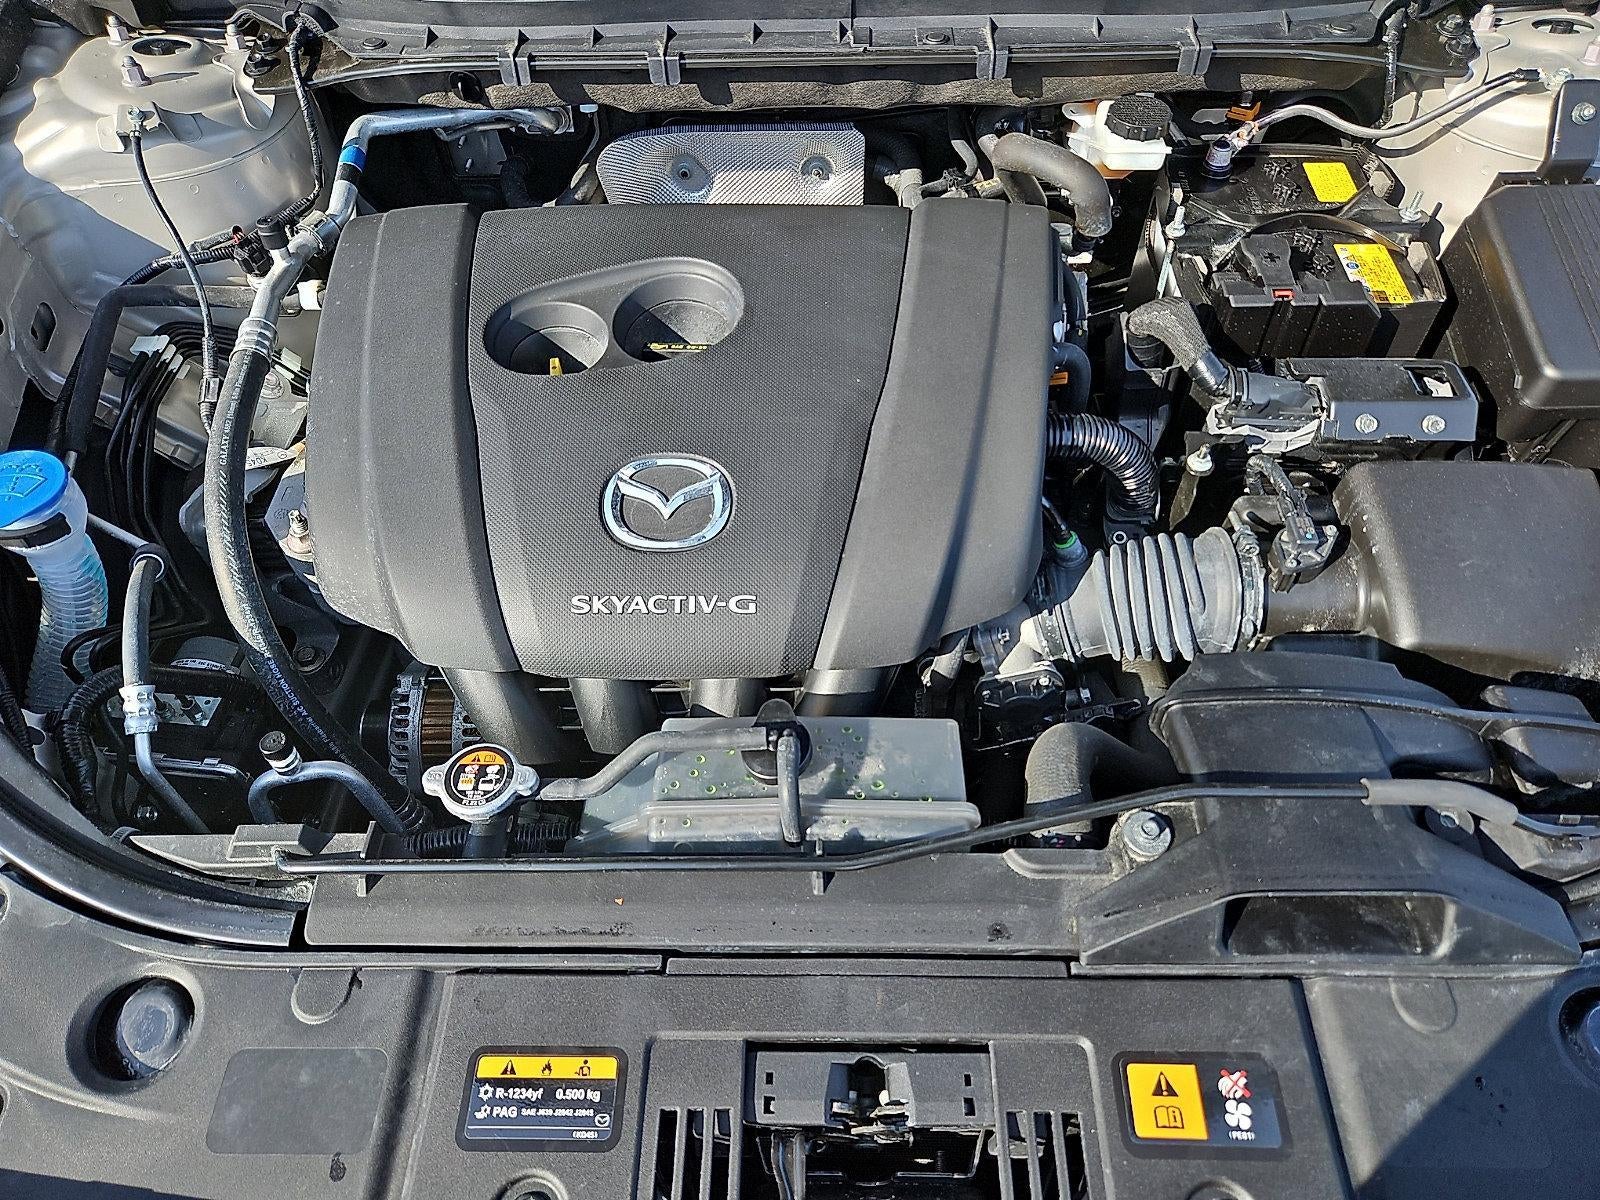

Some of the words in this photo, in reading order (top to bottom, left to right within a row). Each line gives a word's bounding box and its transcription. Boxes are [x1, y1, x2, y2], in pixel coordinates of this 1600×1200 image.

[219, 434, 229, 465] GALAXY
[570, 594, 758, 615] SKYACTIV-G
[266, 657, 282, 679] HOSE
[277, 677, 300, 706] SUCTION
[296, 704, 308, 717] A/C
[495, 1087, 544, 1102] R-1234yf
[555, 1088, 584, 1100] 0.500
[586, 1088, 600, 1102] kg
[492, 1106, 518, 1118] PAG
